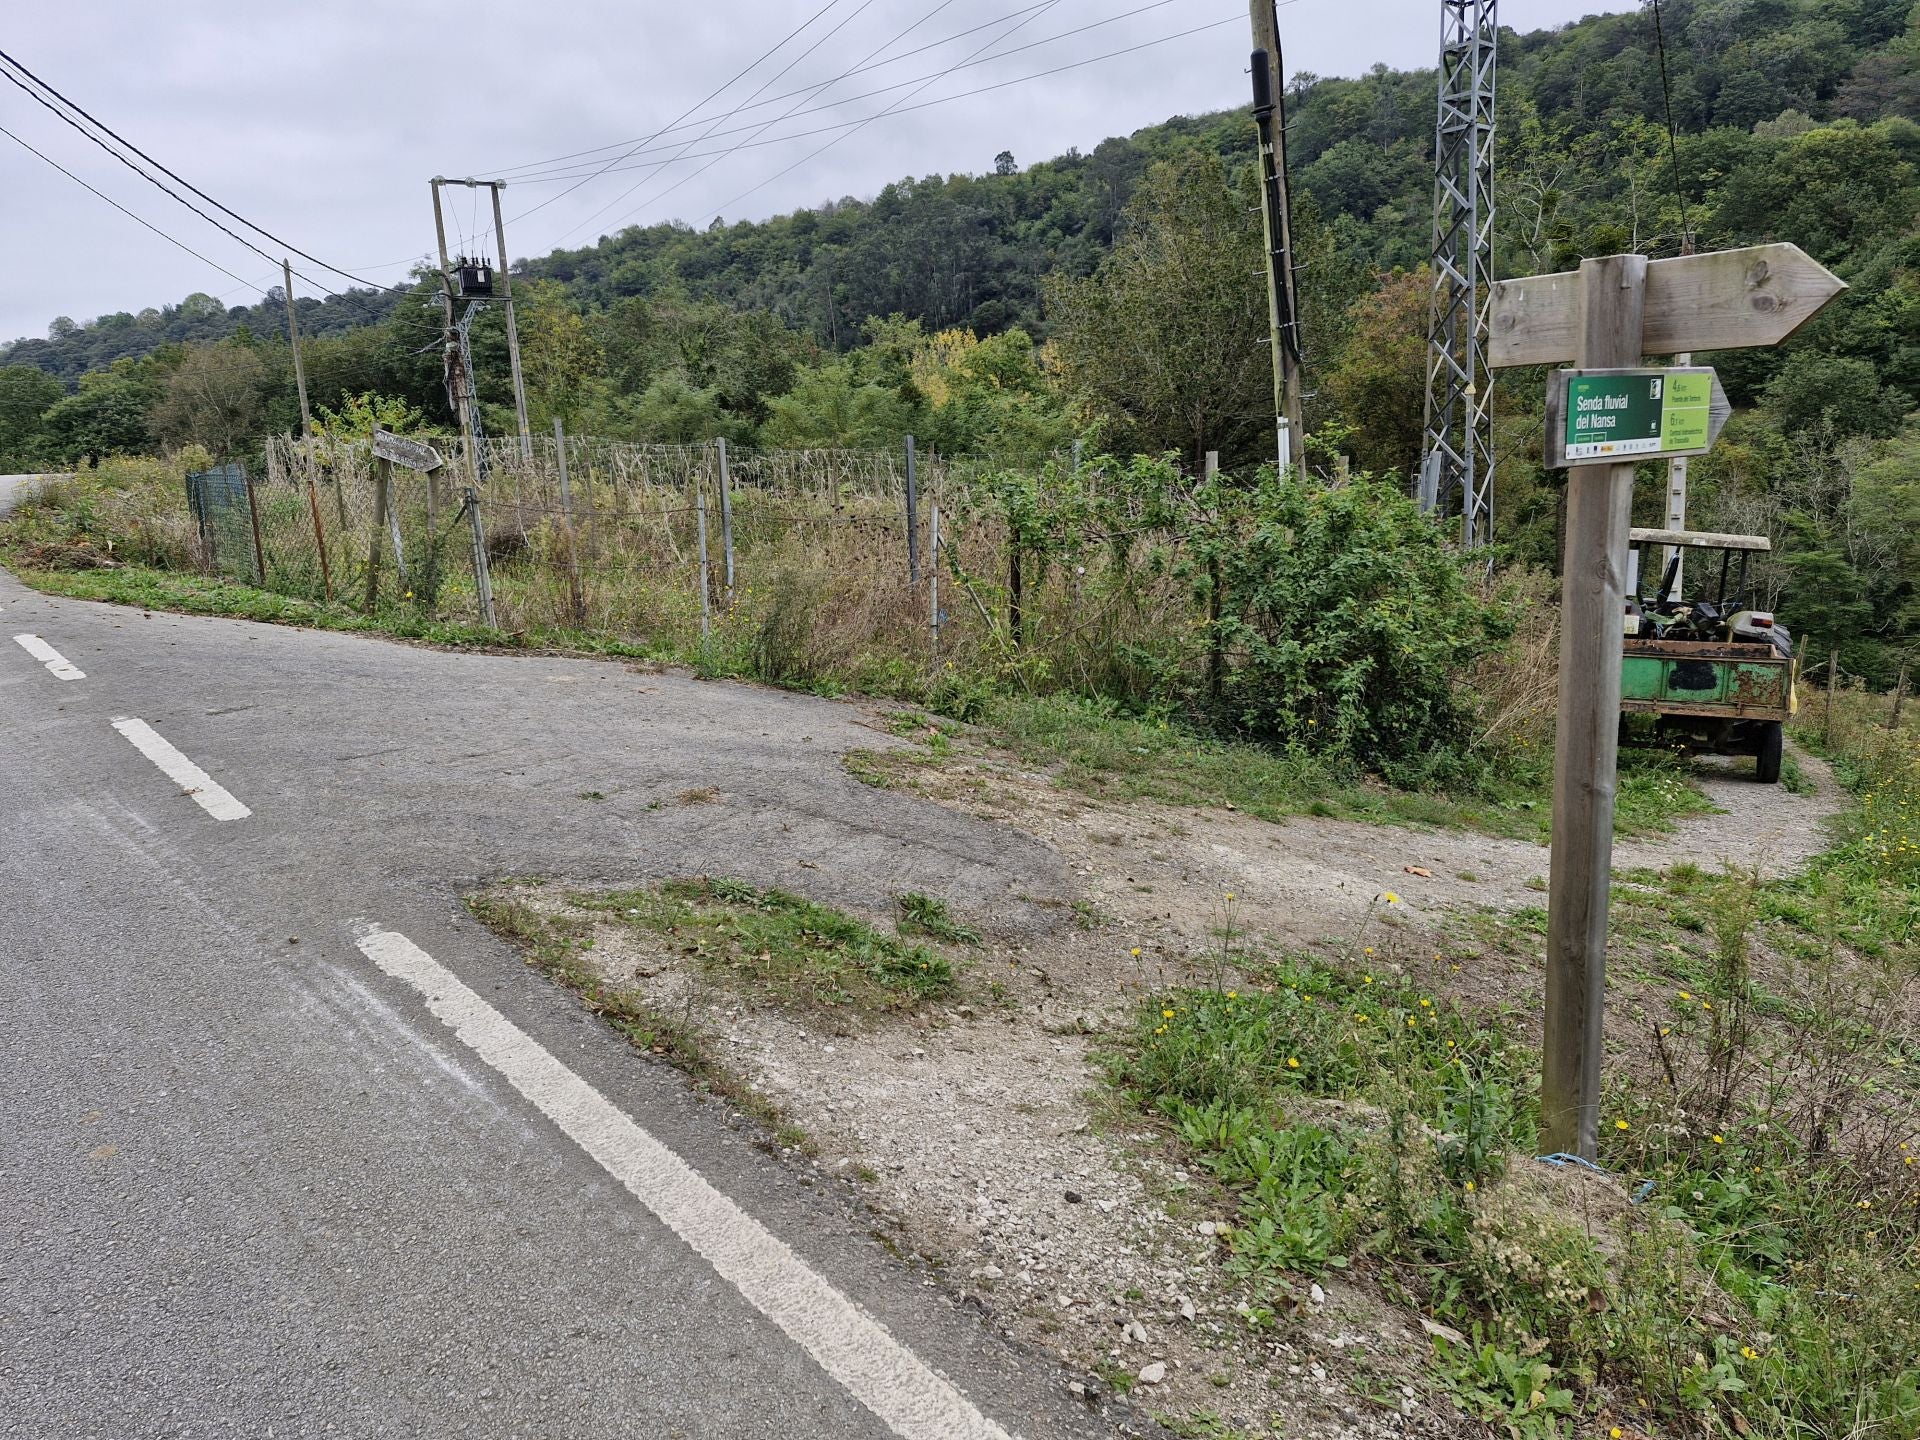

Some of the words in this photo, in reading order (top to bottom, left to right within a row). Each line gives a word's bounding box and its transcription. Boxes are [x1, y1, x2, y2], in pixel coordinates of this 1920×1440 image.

[1577, 395, 1603, 411] Senda
[1604, 393, 1629, 410] fluvial
[1576, 413, 1589, 430] del
[1590, 413, 1616, 429] Nansa
